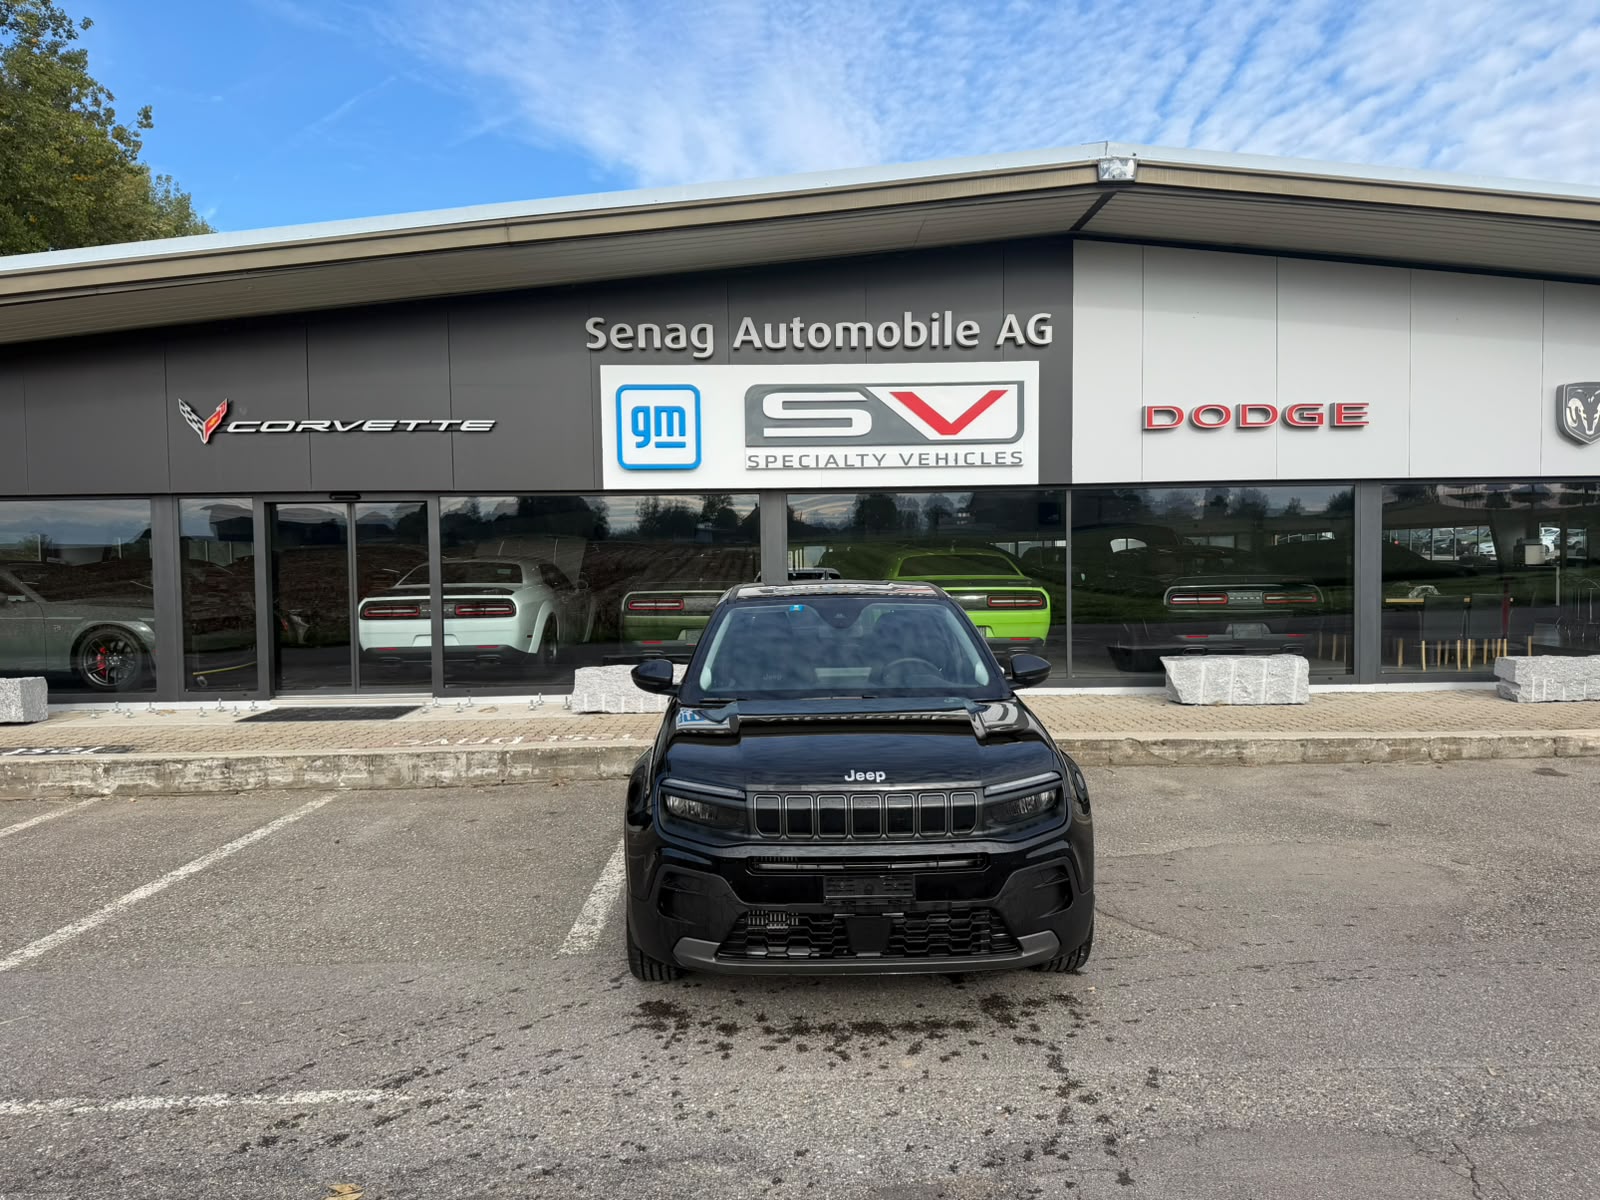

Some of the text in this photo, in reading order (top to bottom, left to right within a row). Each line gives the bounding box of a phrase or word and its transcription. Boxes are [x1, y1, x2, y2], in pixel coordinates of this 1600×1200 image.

[585, 311, 1053, 357] Senag Automobile AG
[226, 420, 496, 433] CORVETTE
[631, 405, 686, 448] gm
[762, 389, 1009, 438] SV
[1143, 402, 1370, 430] DODGE
[747, 450, 1024, 469] SPECIALTY VEHICLES
[844, 769, 886, 783] Jeep
